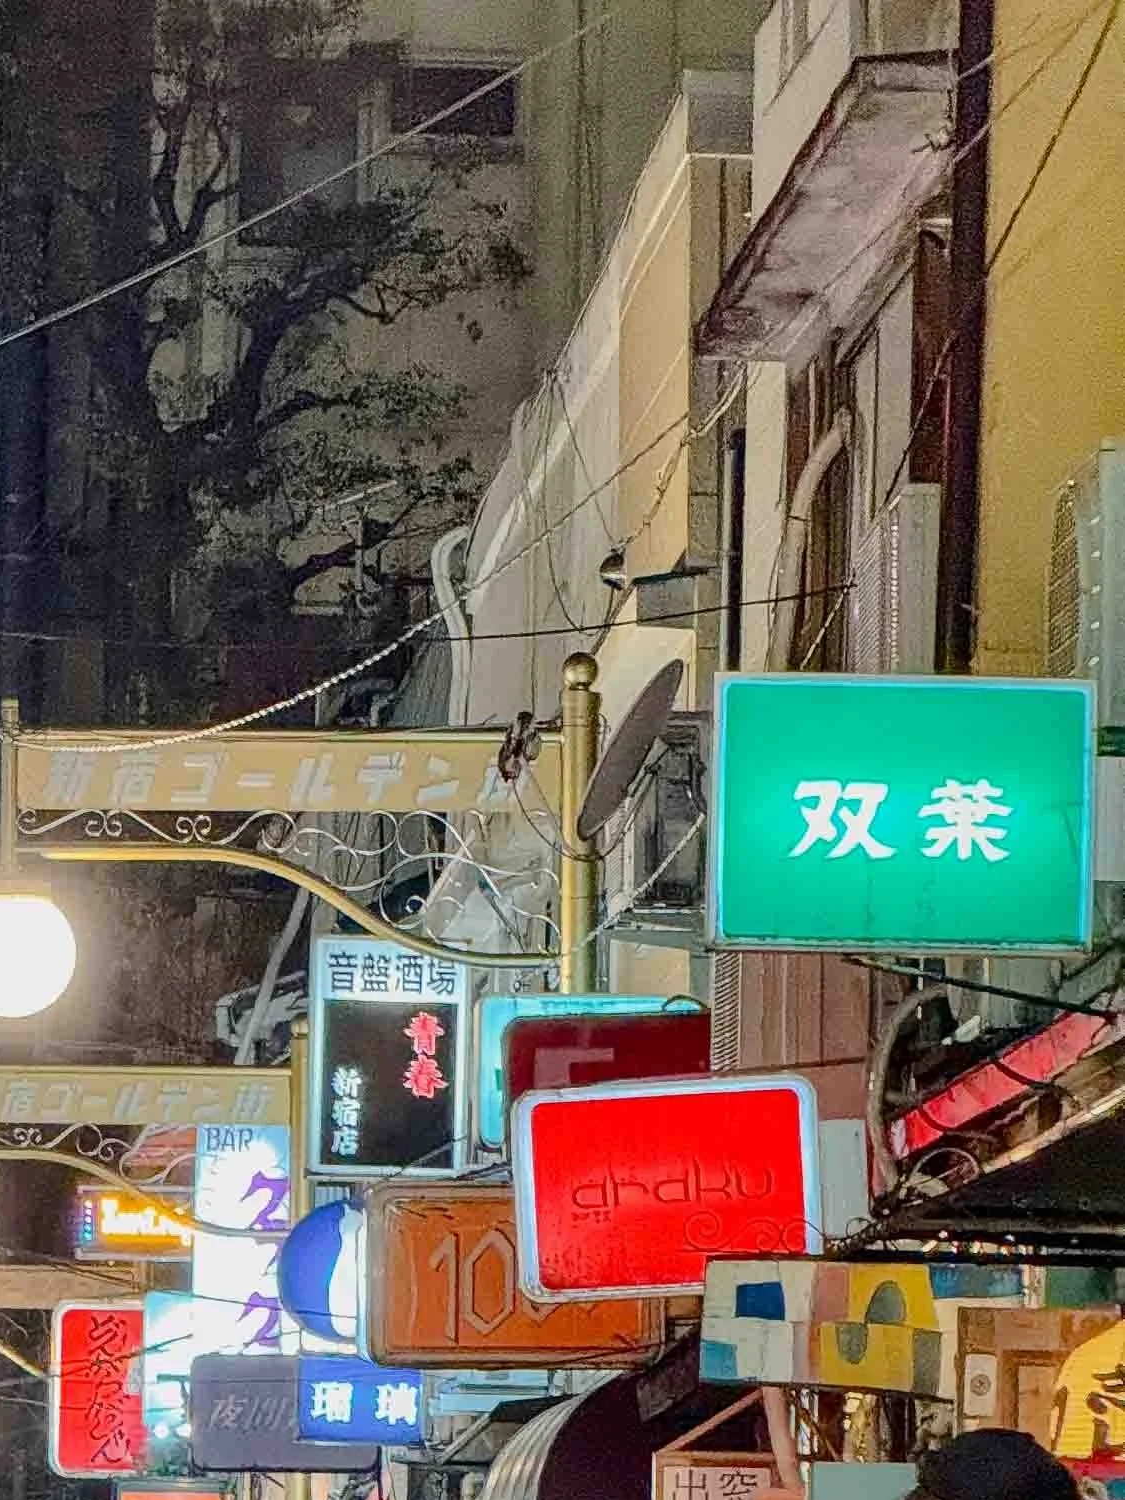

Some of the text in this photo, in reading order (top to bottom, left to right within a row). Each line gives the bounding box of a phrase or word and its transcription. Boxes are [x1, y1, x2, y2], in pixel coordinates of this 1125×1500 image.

[788, 778, 1013, 863] 双葉
[329, 951, 458, 994] 音盤酒場
[331, 1064, 363, 1156] 新宿店
[204, 1127, 253, 1152] BAR
[571, 1156, 773, 1209] araku
